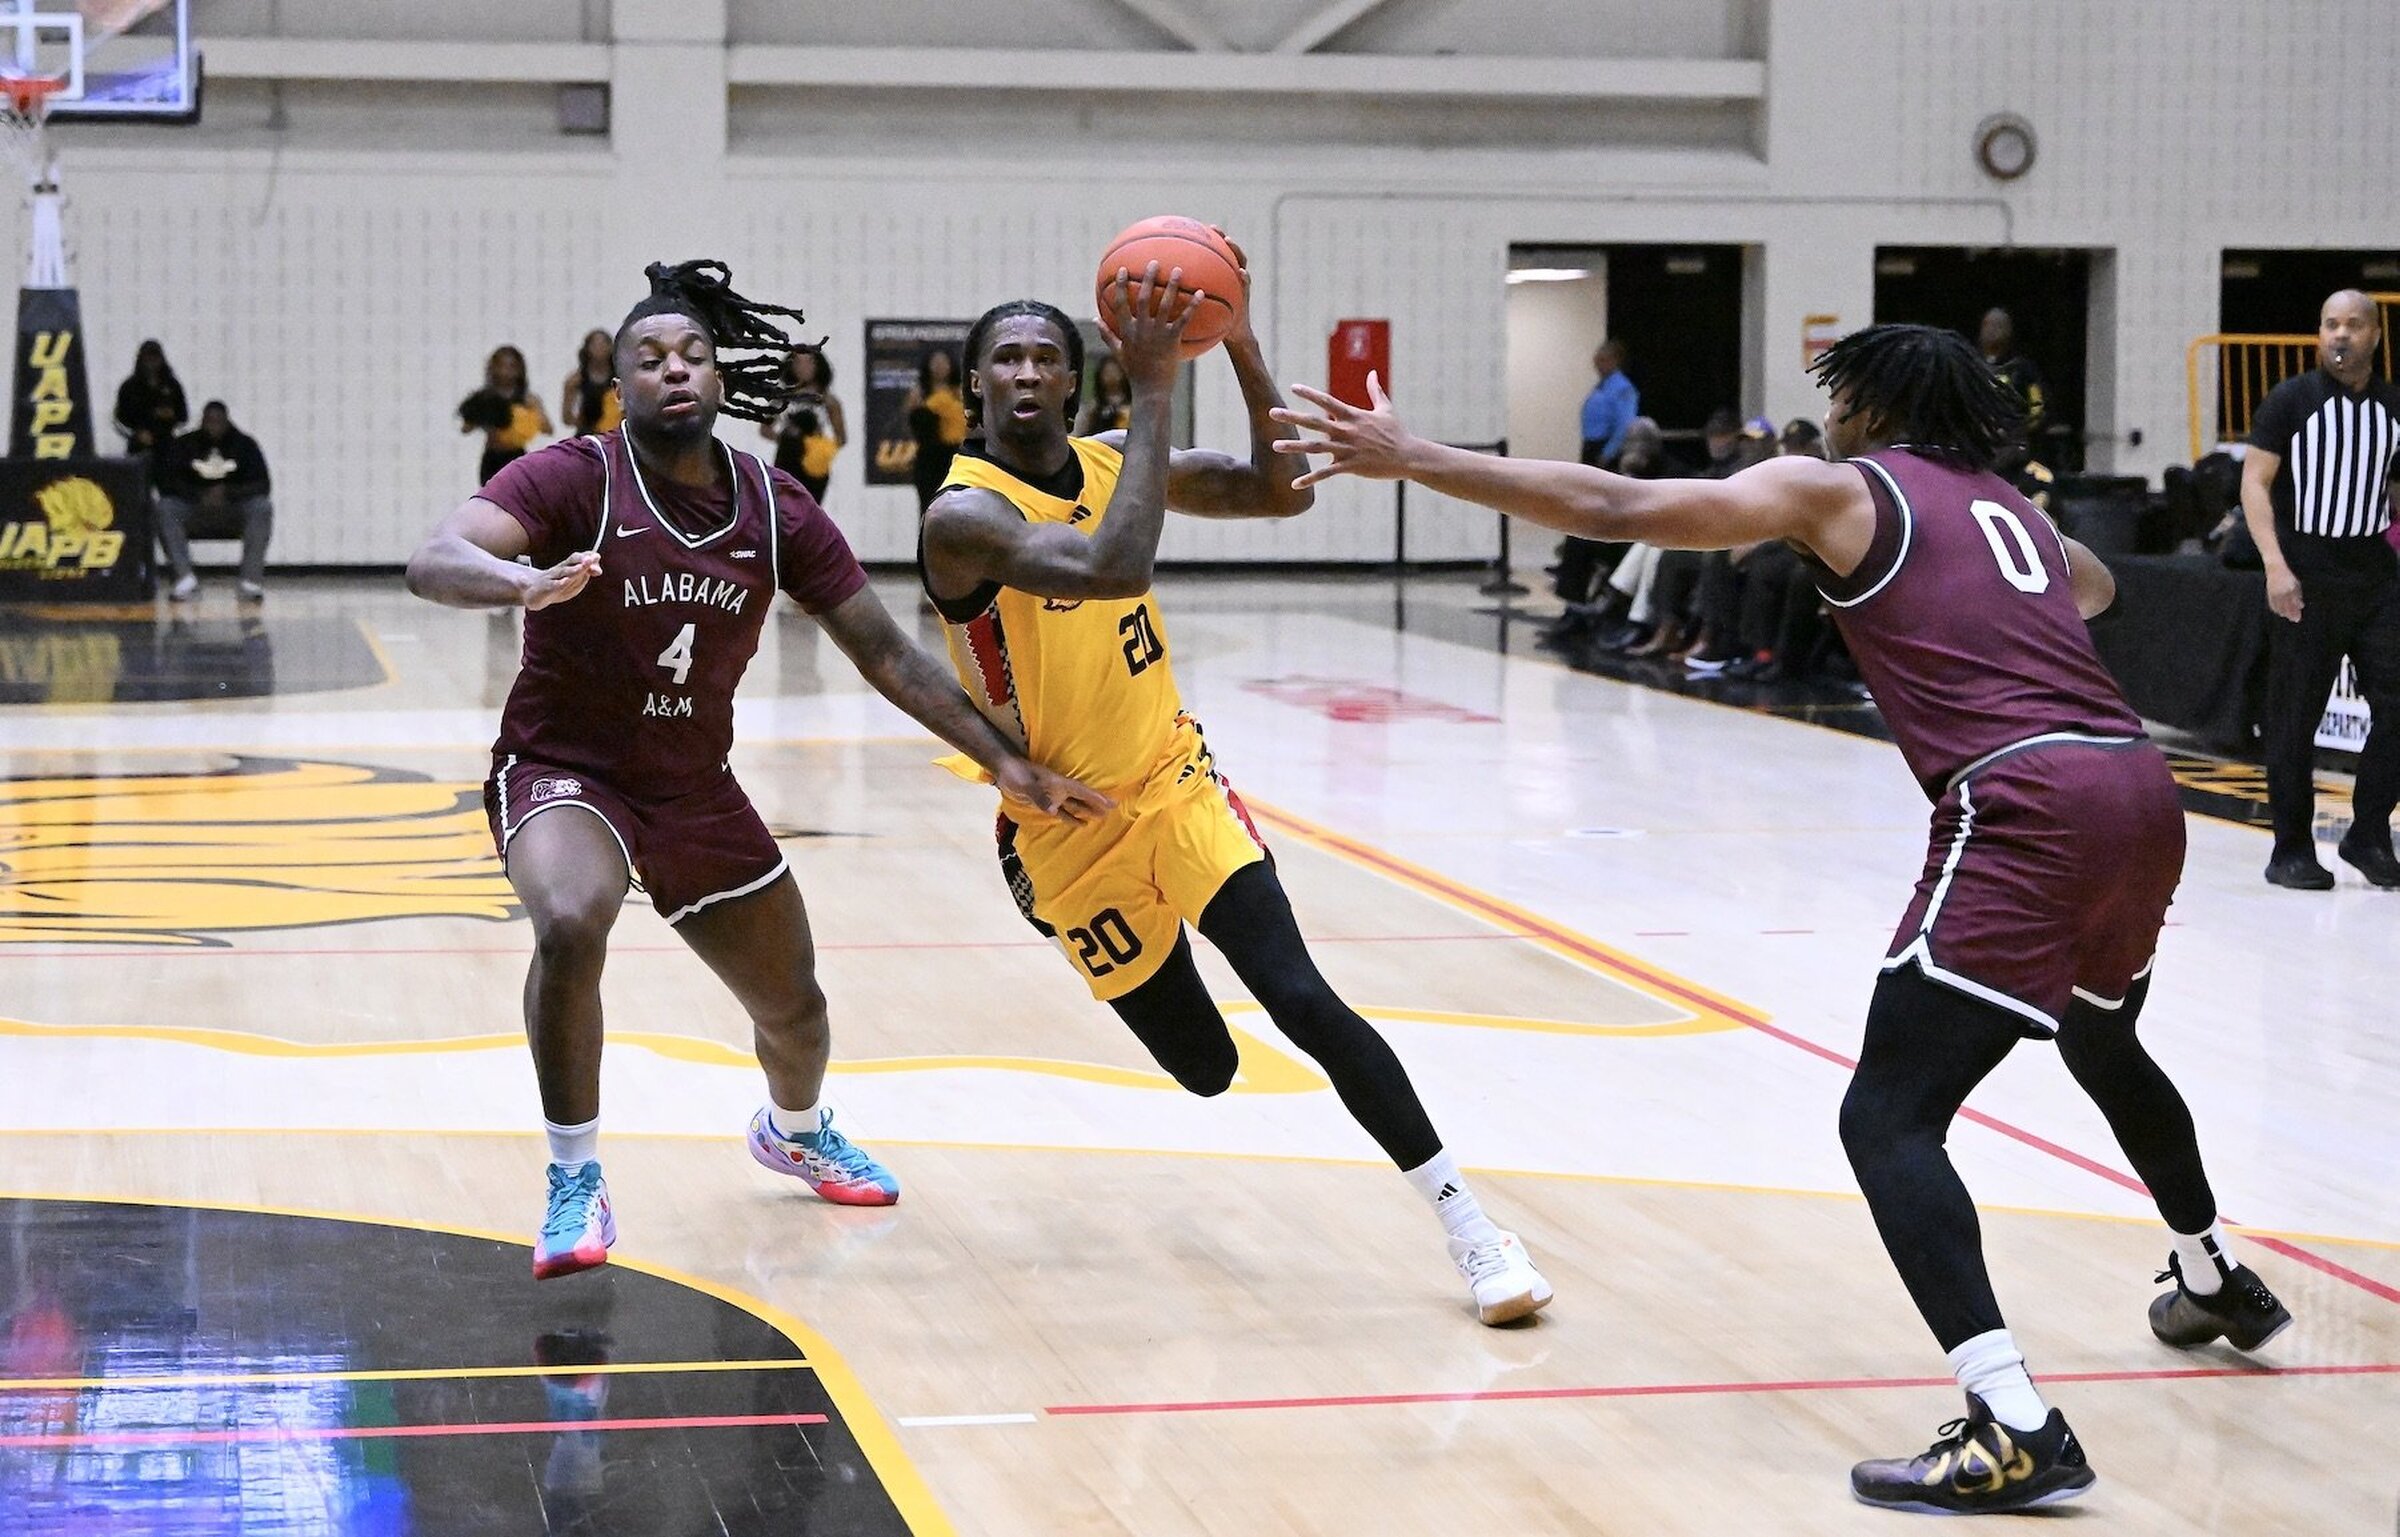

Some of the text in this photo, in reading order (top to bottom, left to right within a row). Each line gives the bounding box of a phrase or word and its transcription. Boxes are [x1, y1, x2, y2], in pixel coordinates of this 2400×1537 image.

[1970, 501, 2050, 594] 0
[624, 573, 748, 614] ALABAMA
[657, 623, 696, 685] 4
[1119, 603, 1164, 677] 20
[642, 692, 693, 718] A&M
[1066, 908, 1142, 977] 20
